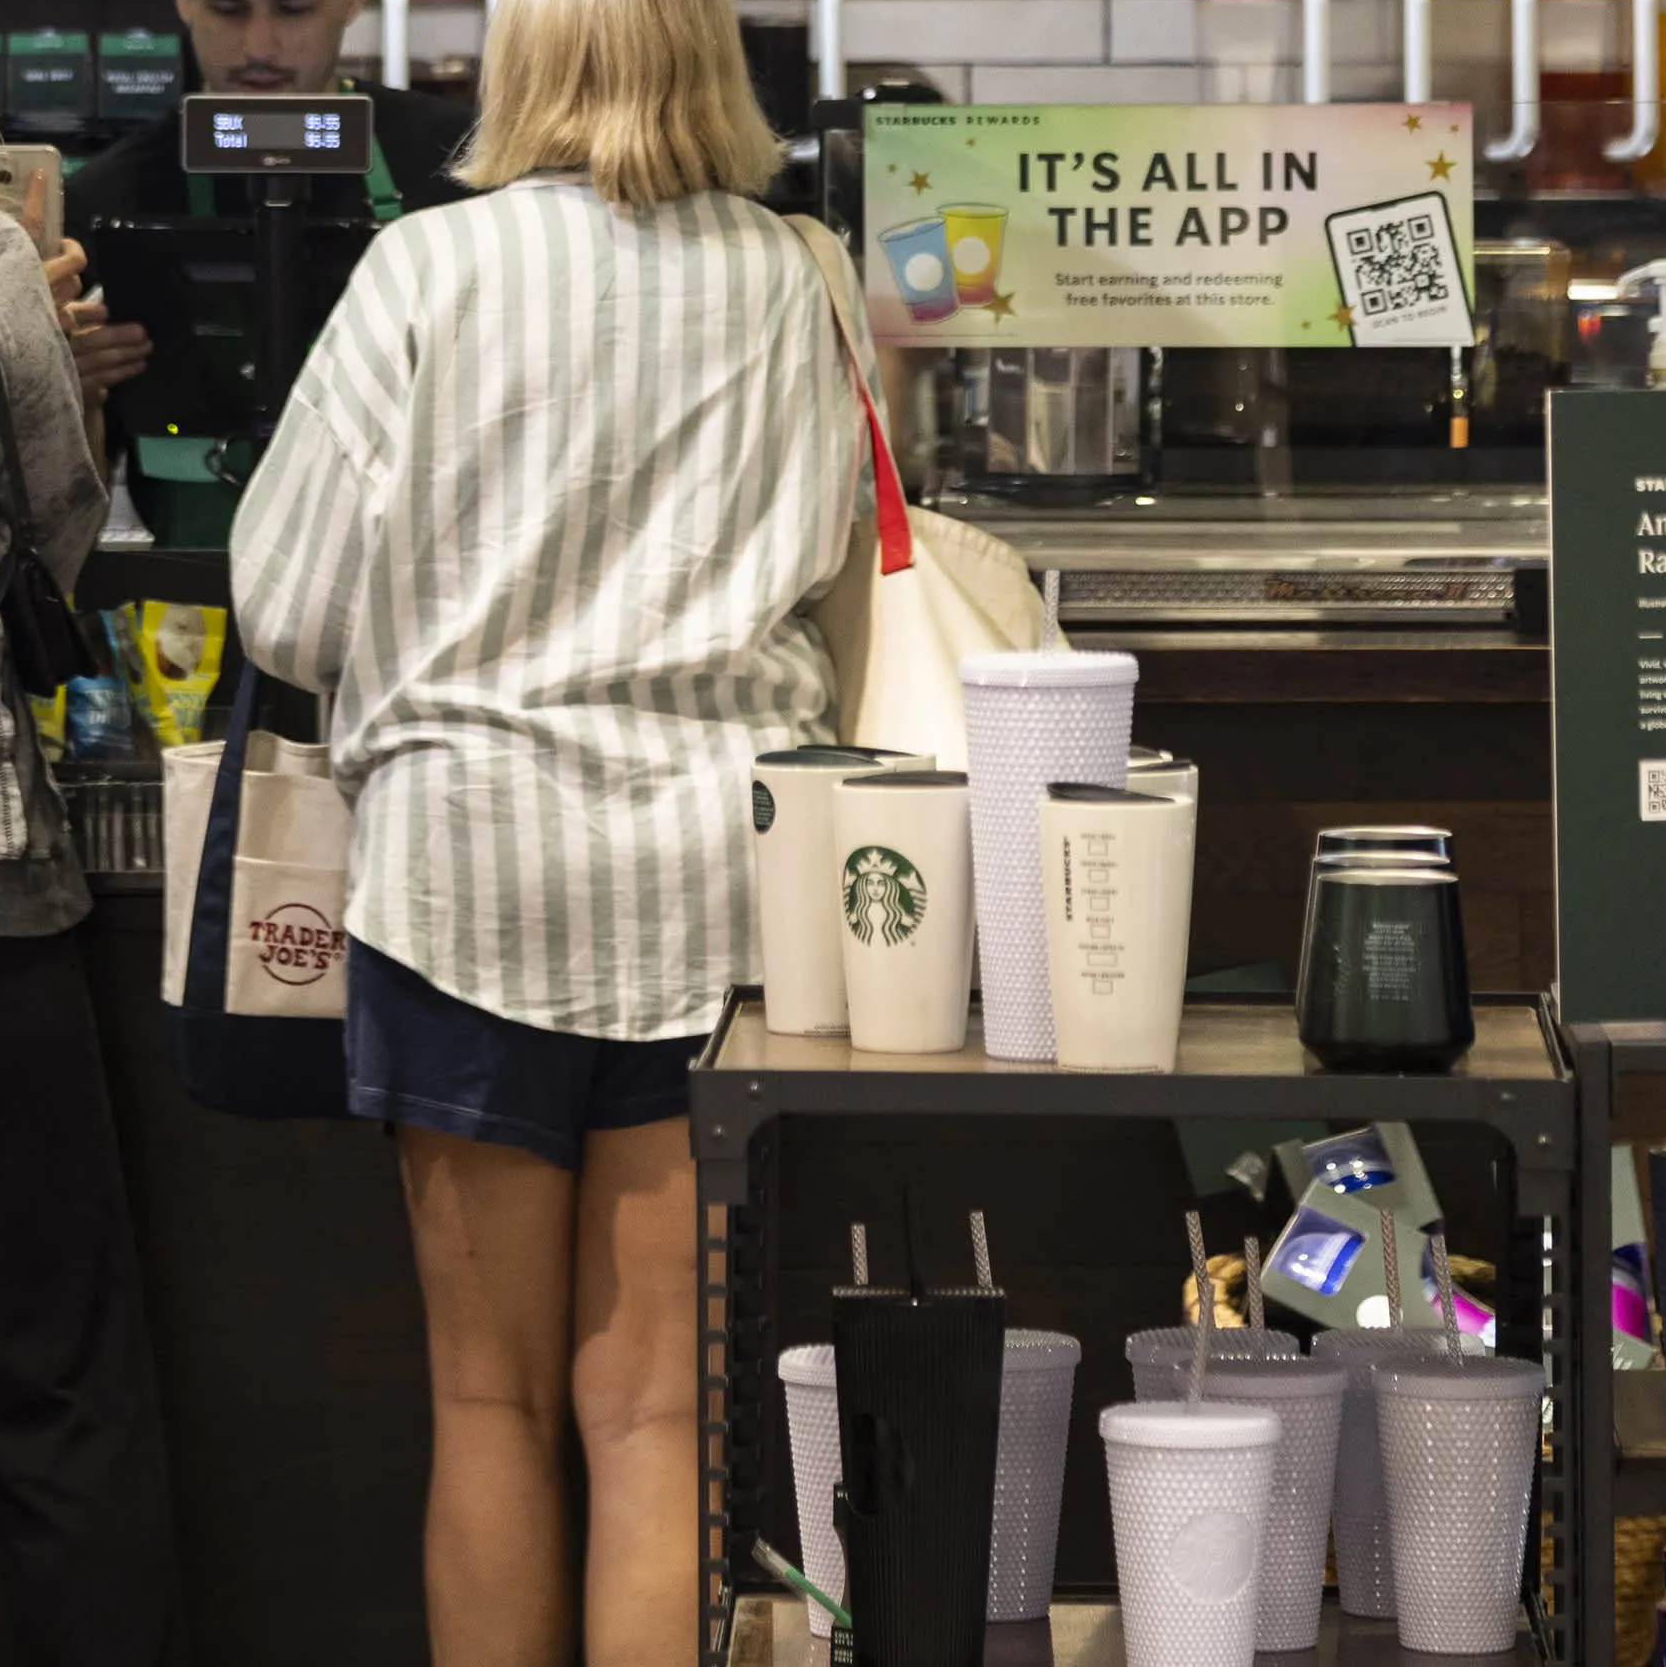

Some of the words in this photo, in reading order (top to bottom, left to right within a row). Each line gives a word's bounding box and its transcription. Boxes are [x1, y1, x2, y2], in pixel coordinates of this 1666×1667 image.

[876, 116, 956, 126] STARBUCKS
[966, 116, 1040, 126] REWARDS
[213, 131, 248, 148] Total
[1018, 152, 1120, 193] IT'S
[1142, 152, 1237, 193] ALL
[1262, 152, 1317, 193] IN
[1048, 207, 1154, 247] THE
[1175, 207, 1289, 247] APP
[1055, 273, 1094, 288] Start
[1099, 273, 1158, 292] earning
[1162, 273, 1191, 287] and
[1195, 273, 1283, 292] redeeming
[1066, 293, 1098, 307] free
[1101, 293, 1173, 307] favorites
[1176, 293, 1191, 307] at
[1194, 293, 1226, 307] this
[1230, 293, 1274, 307] store.
[1063, 836, 1072, 922] STARBUCKS
[250, 922, 346, 950] TRADER
[259, 945, 331, 969] JOE'S
